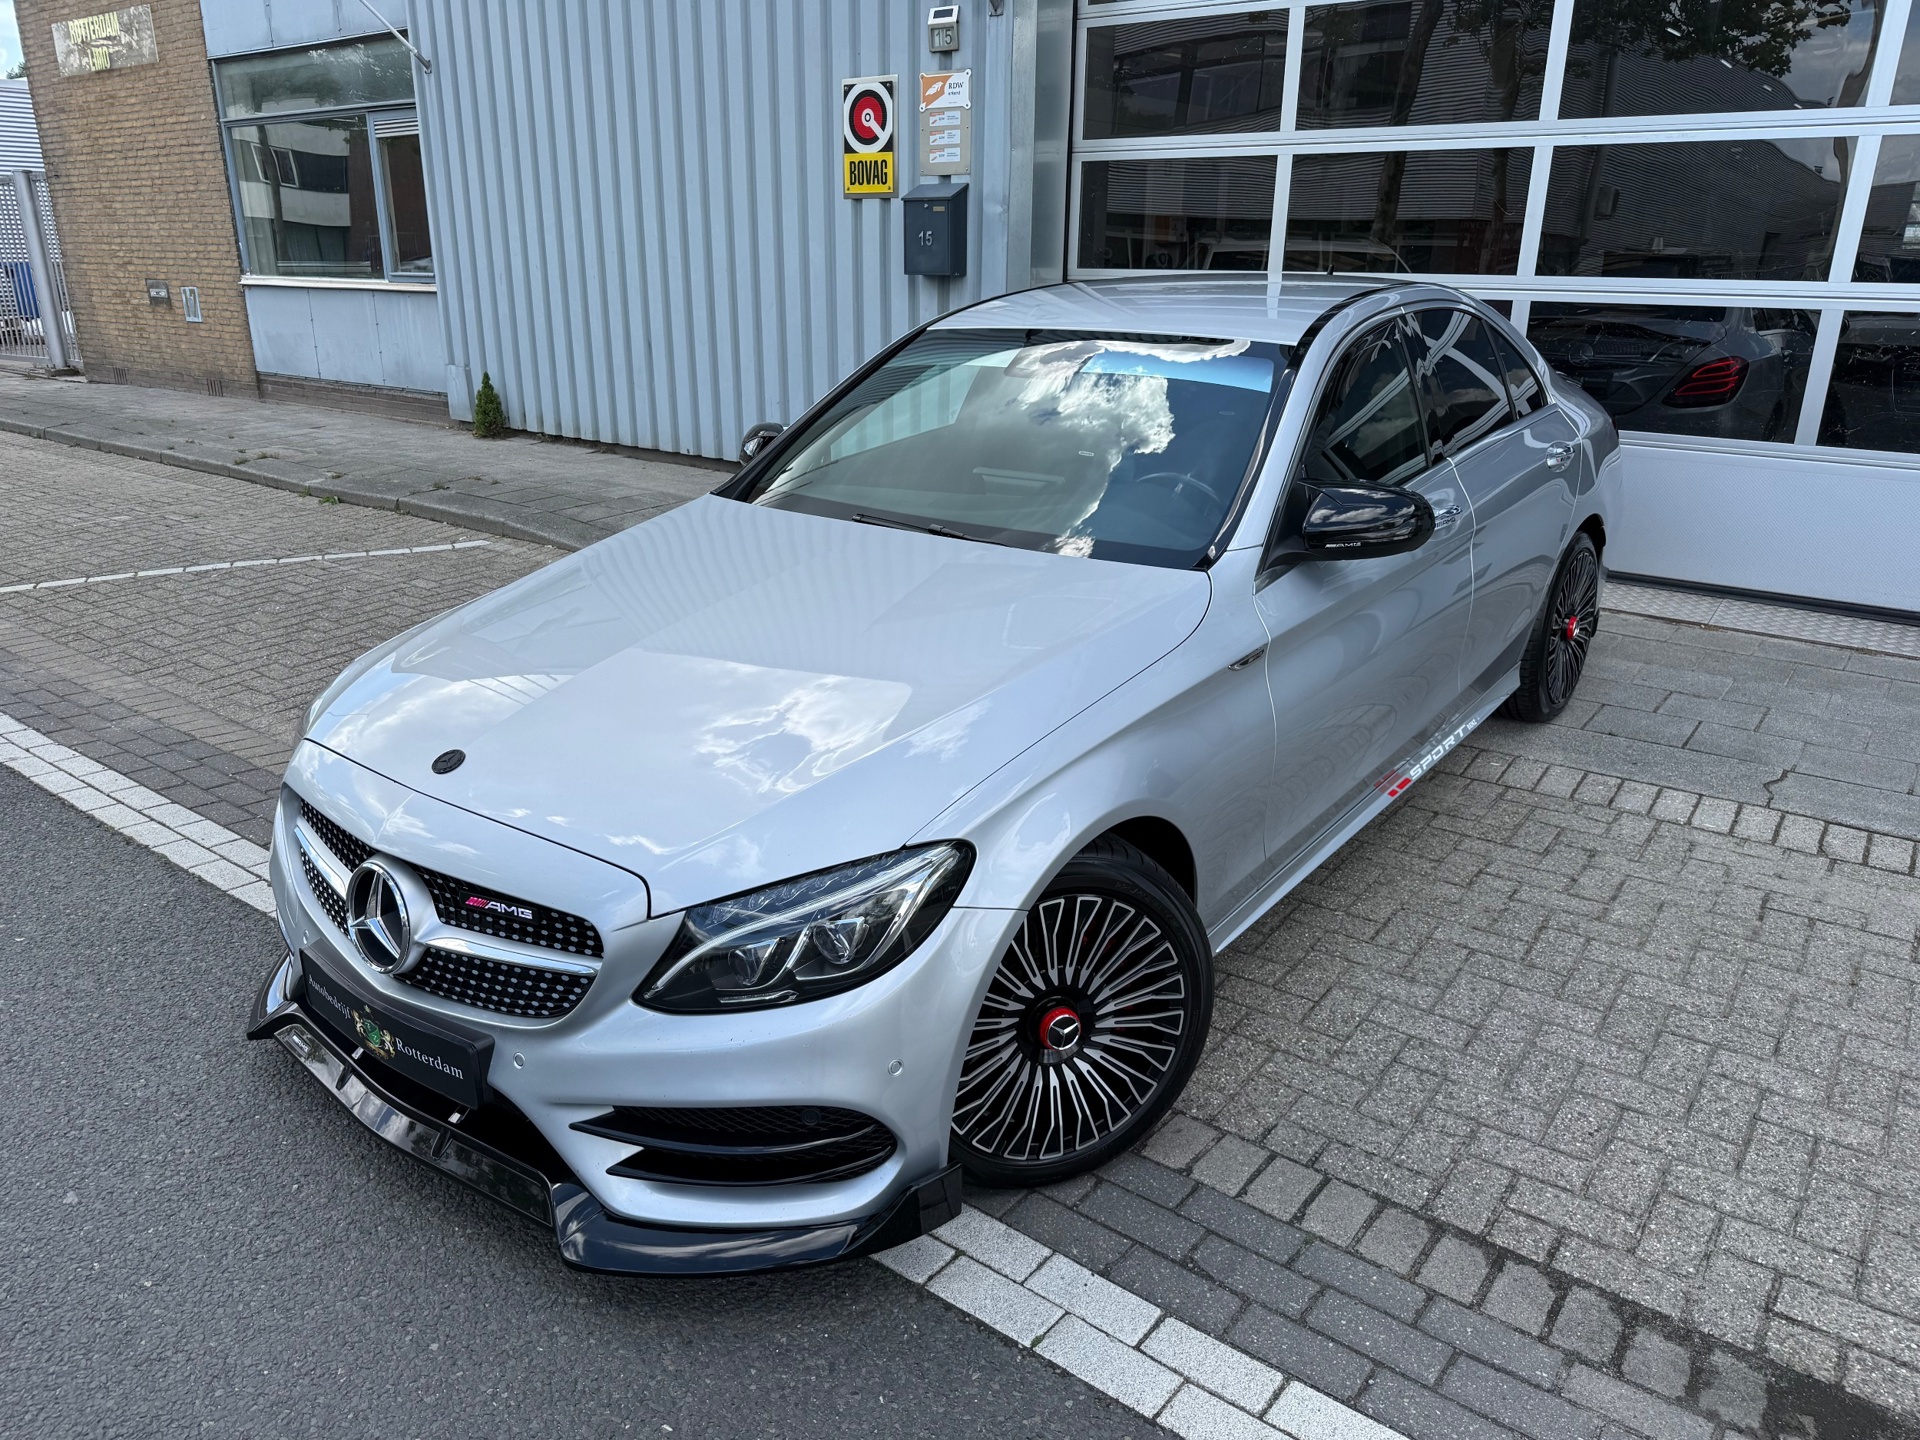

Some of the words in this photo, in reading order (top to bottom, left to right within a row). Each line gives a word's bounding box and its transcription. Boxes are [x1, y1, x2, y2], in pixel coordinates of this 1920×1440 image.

[68, 11, 120, 45] ROTTERDAM
[935, 29, 952, 46] 15
[87, 46, 111, 71] LIMO
[948, 82, 964, 90] RDW
[849, 159, 888, 186] BOVAG
[918, 230, 933, 246] 15
[1334, 541, 1361, 549] AMG
[1409, 724, 1466, 780] SPORT
[484, 901, 533, 920] AMG
[308, 974, 351, 1019] Autobedrijf
[394, 1036, 464, 1080] Rotterdam
